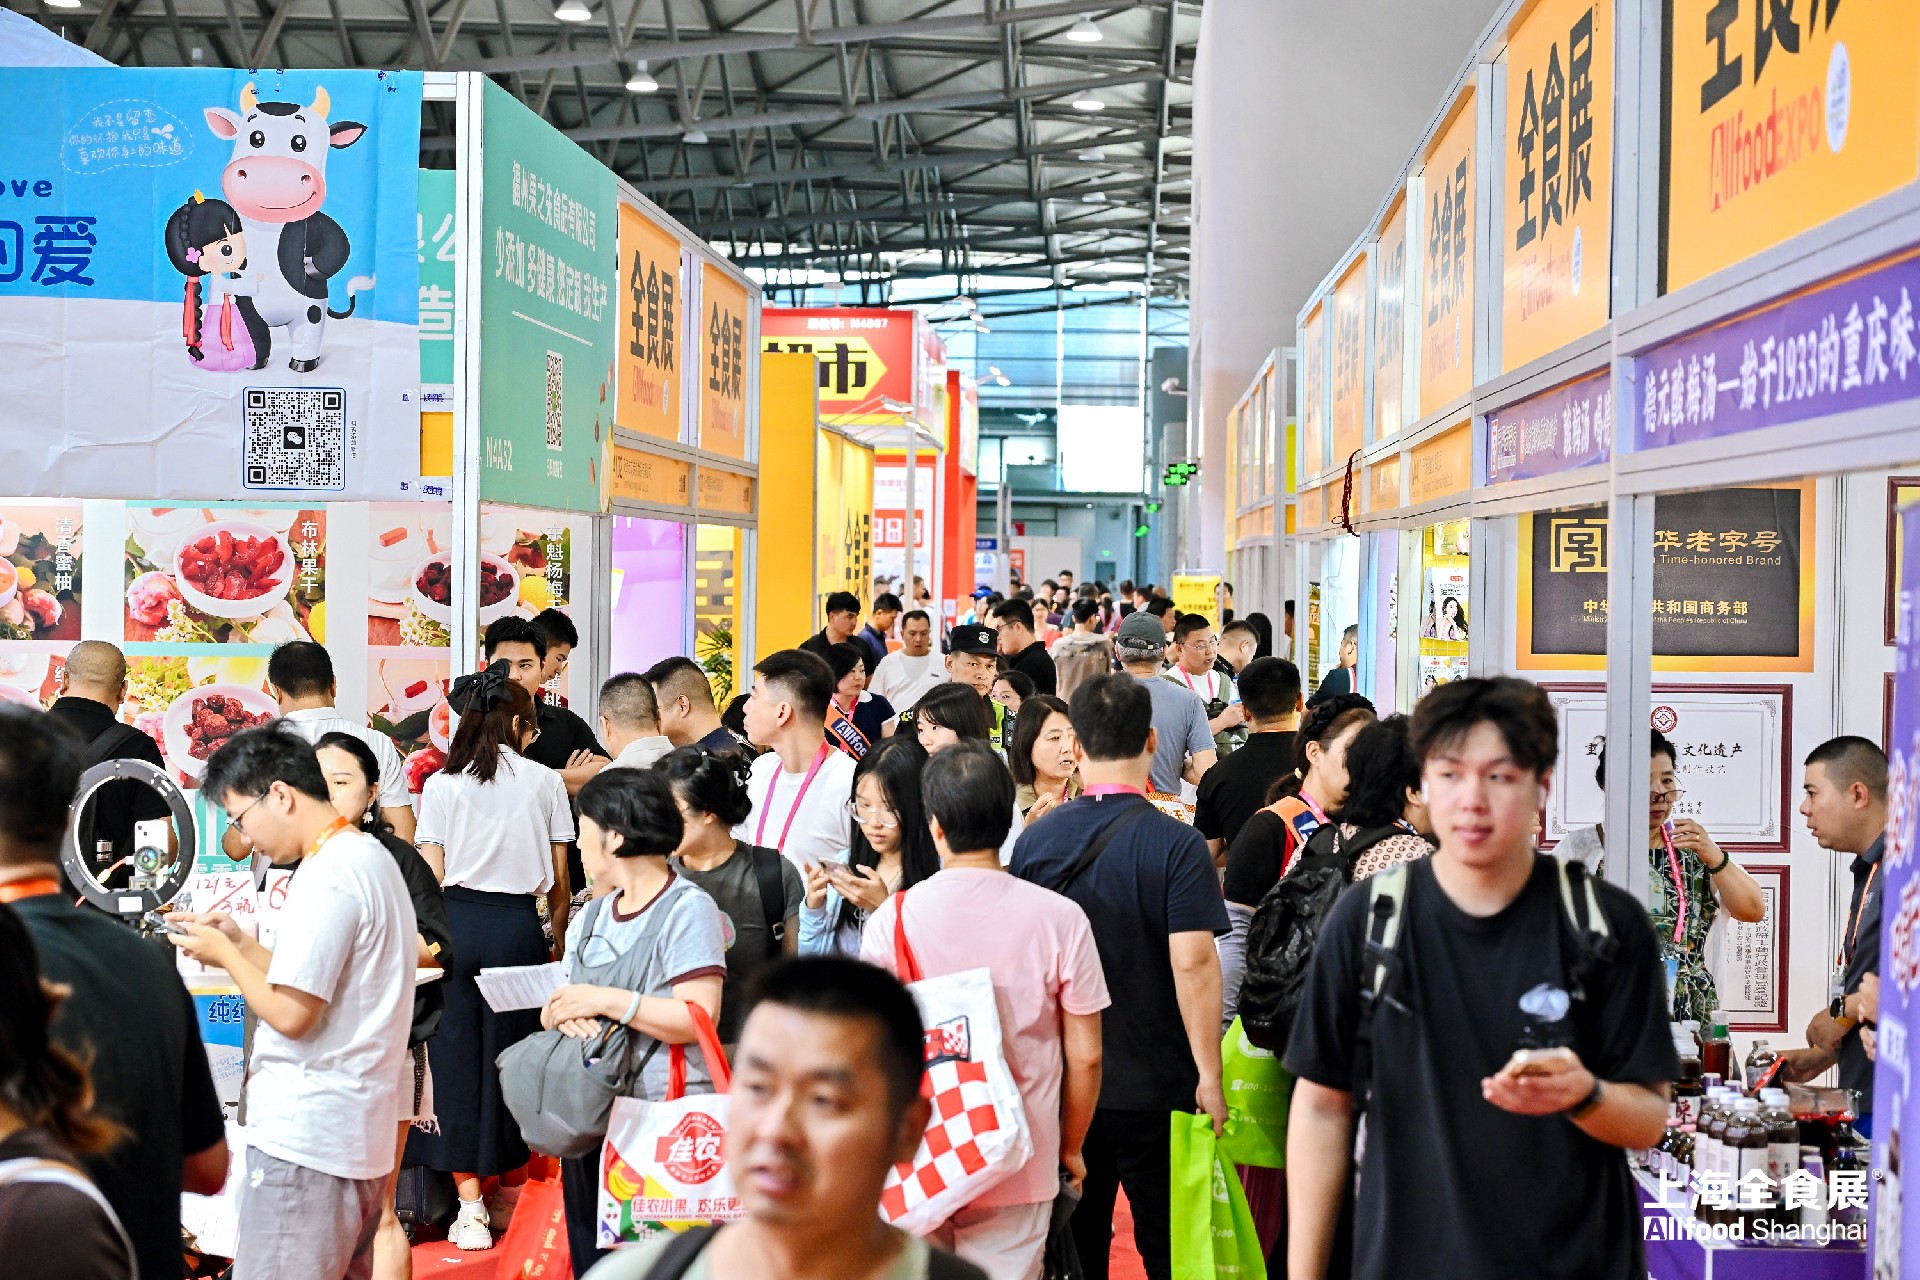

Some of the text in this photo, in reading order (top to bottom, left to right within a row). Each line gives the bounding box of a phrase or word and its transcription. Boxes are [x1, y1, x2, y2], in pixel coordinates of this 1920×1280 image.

[1515, 6, 1594, 252] 全食展
[1427, 156, 1468, 327] 全食展
[631, 249, 675, 372] 全食展
[709, 301, 743, 401] 全食展
[55, 516, 73, 591] 清香蜜柚
[301, 521, 319, 593] 布林果干
[1660, 554, 1781, 566] Time-honored Brand
[667, 1134, 721, 1163] 佳农
